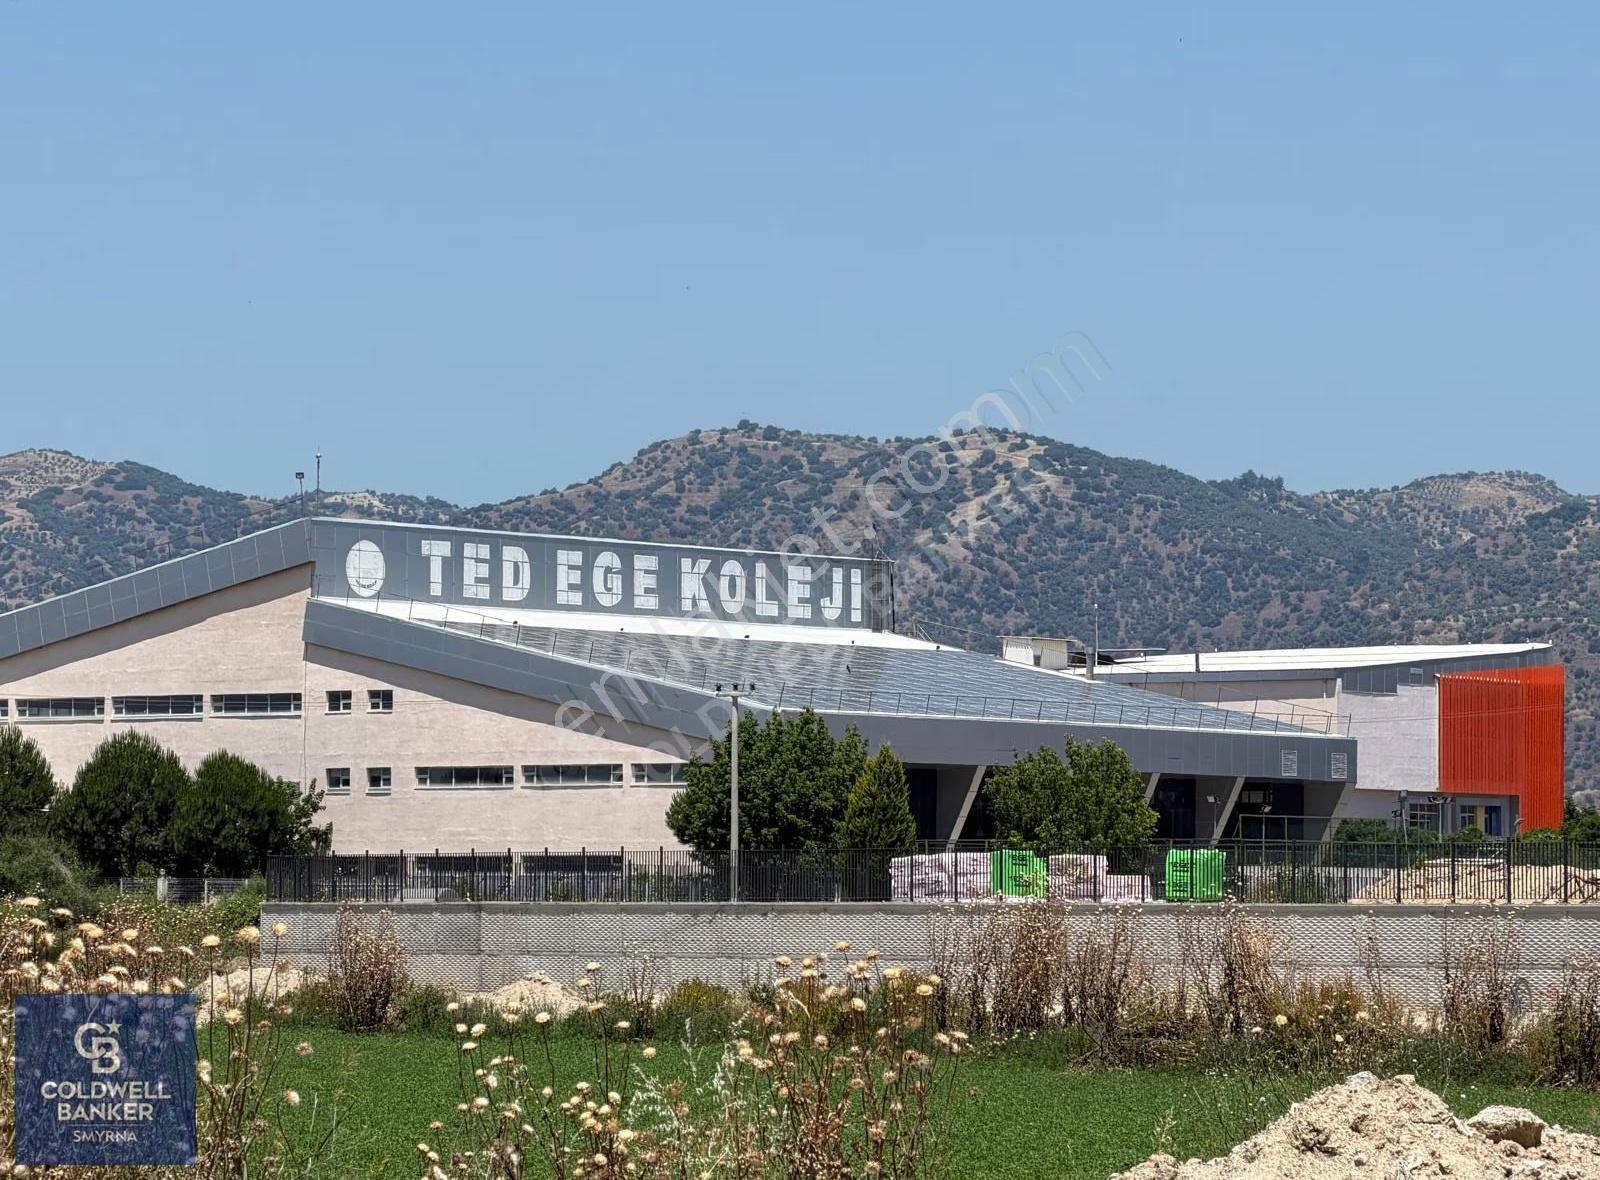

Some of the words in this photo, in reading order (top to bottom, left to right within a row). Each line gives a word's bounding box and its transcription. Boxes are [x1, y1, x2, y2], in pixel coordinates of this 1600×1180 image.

[421, 539, 531, 602] TED
[556, 549, 659, 611] EGE
[681, 557, 862, 622] KOLEJI
